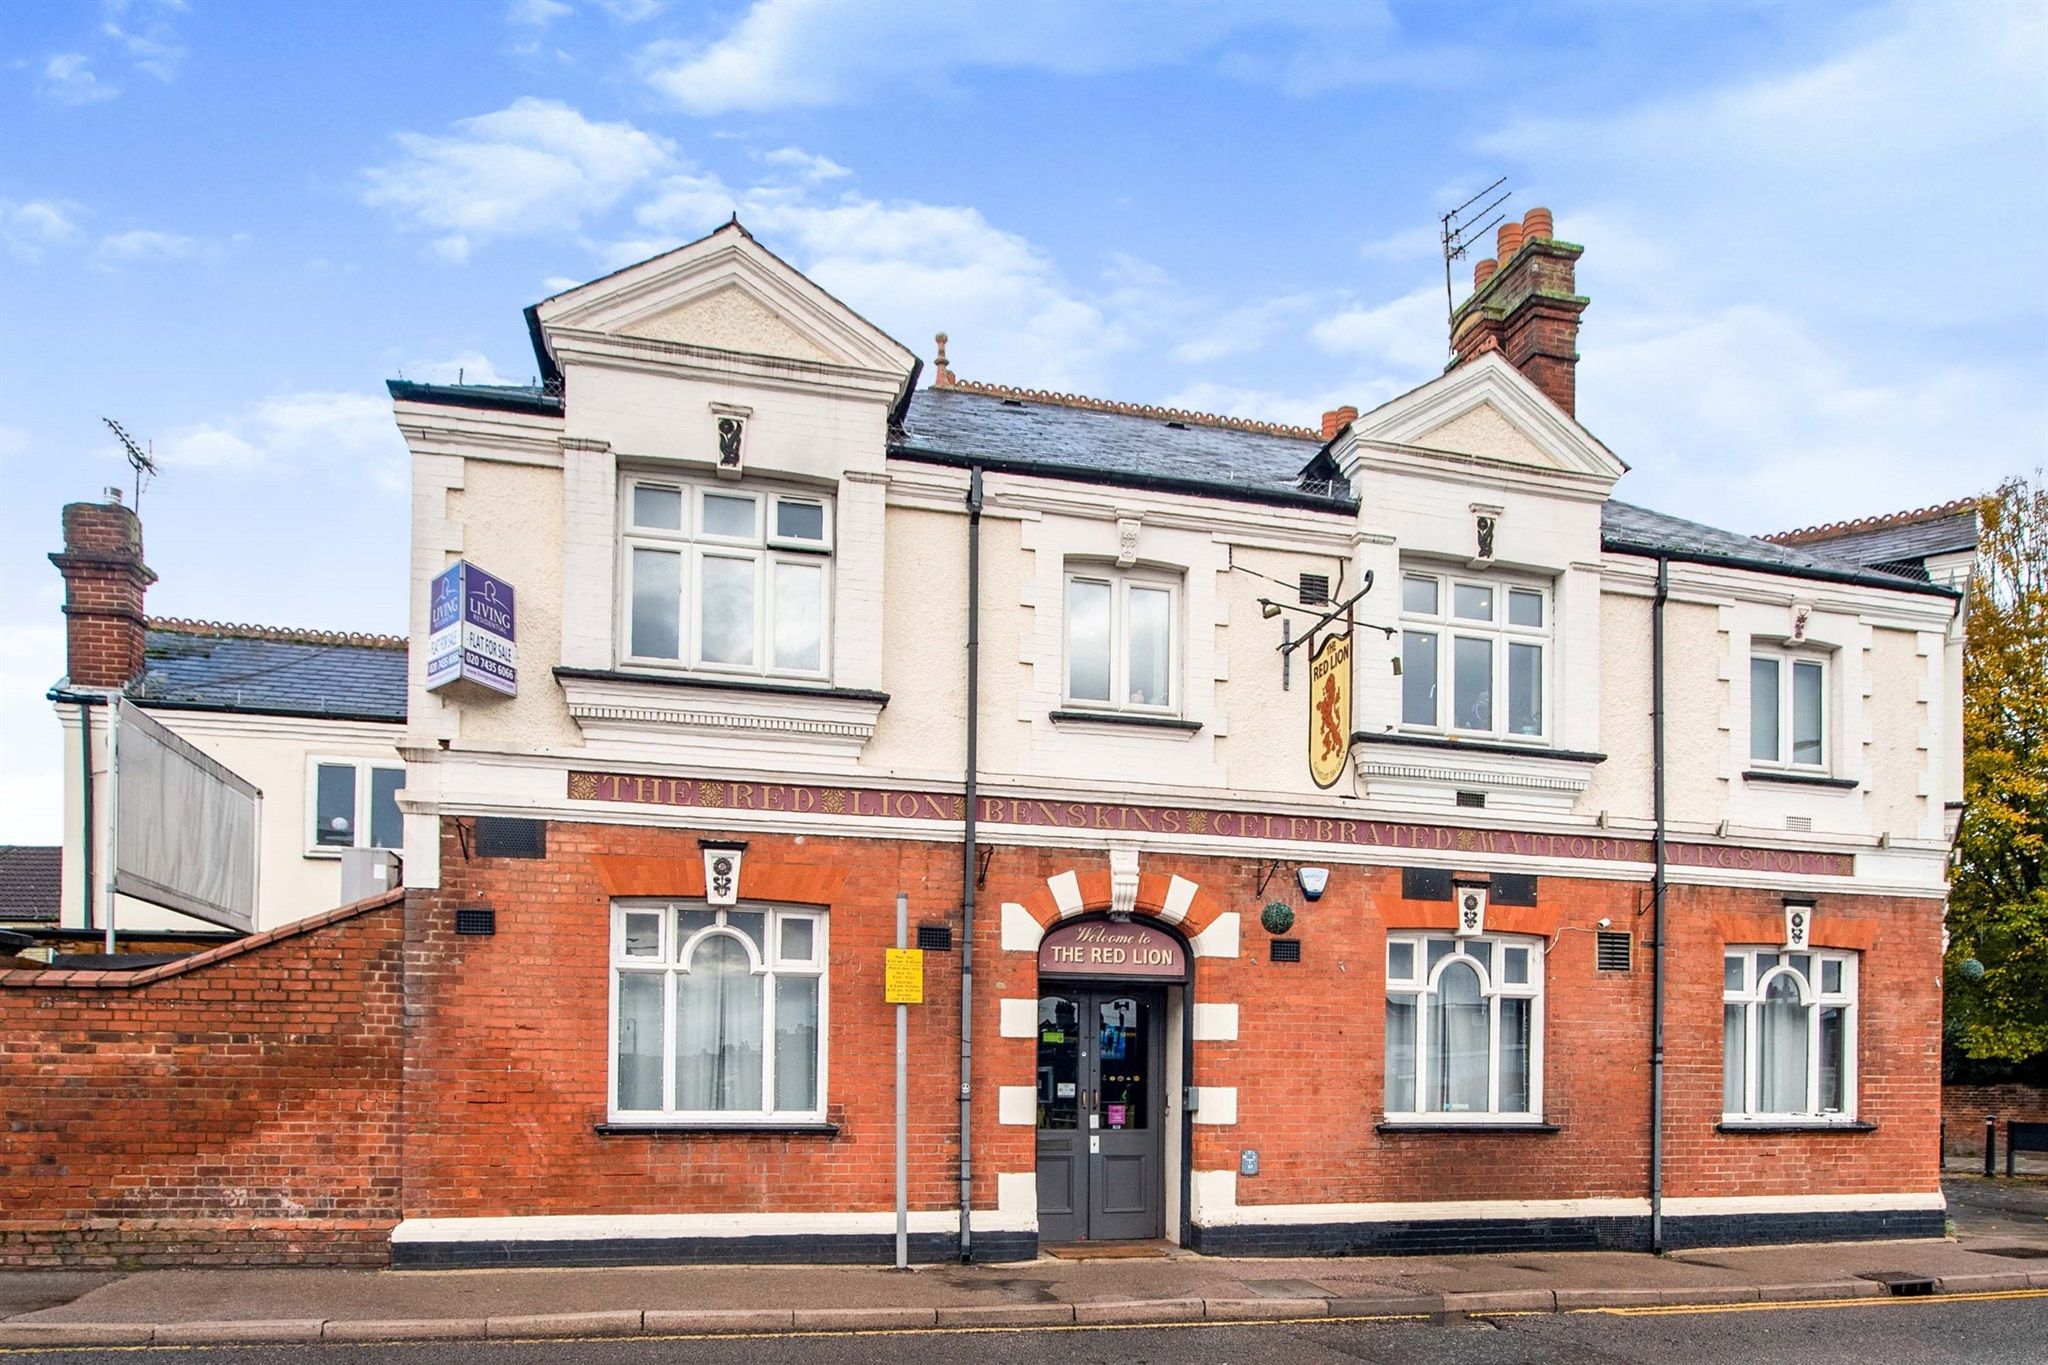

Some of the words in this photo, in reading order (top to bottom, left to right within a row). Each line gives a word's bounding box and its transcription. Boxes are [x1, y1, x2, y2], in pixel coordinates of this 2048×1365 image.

[432, 597, 458, 623] LIVING
[469, 597, 511, 629] LIVING
[469, 631, 484, 650] FLAT
[485, 638, 497, 656] FOR
[498, 644, 512, 663] SALE
[1326, 640, 1337, 656] THE
[466, 651, 480, 666] 020
[480, 657, 497, 673] 7435
[497, 665, 514, 680] 6066
[1313, 659, 1329, 682] RED
[1330, 643, 1349, 671] LION
[603, 775, 692, 806] THE
[728, 782, 815, 812] RED
[851, 790, 949, 820] LION
[982, 799, 1182, 833] BENSKINS
[1213, 813, 1452, 850] CELEBRATED
[1478, 831, 1631, 860] WATFORD
[1739, 849, 1833, 874] STOUT
[1075, 925, 1135, 944] Welcome
[1137, 931, 1151, 945] to
[1051, 946, 1085, 963] THE
[1091, 947, 1126, 964] RED
[1133, 949, 1174, 965] LION
